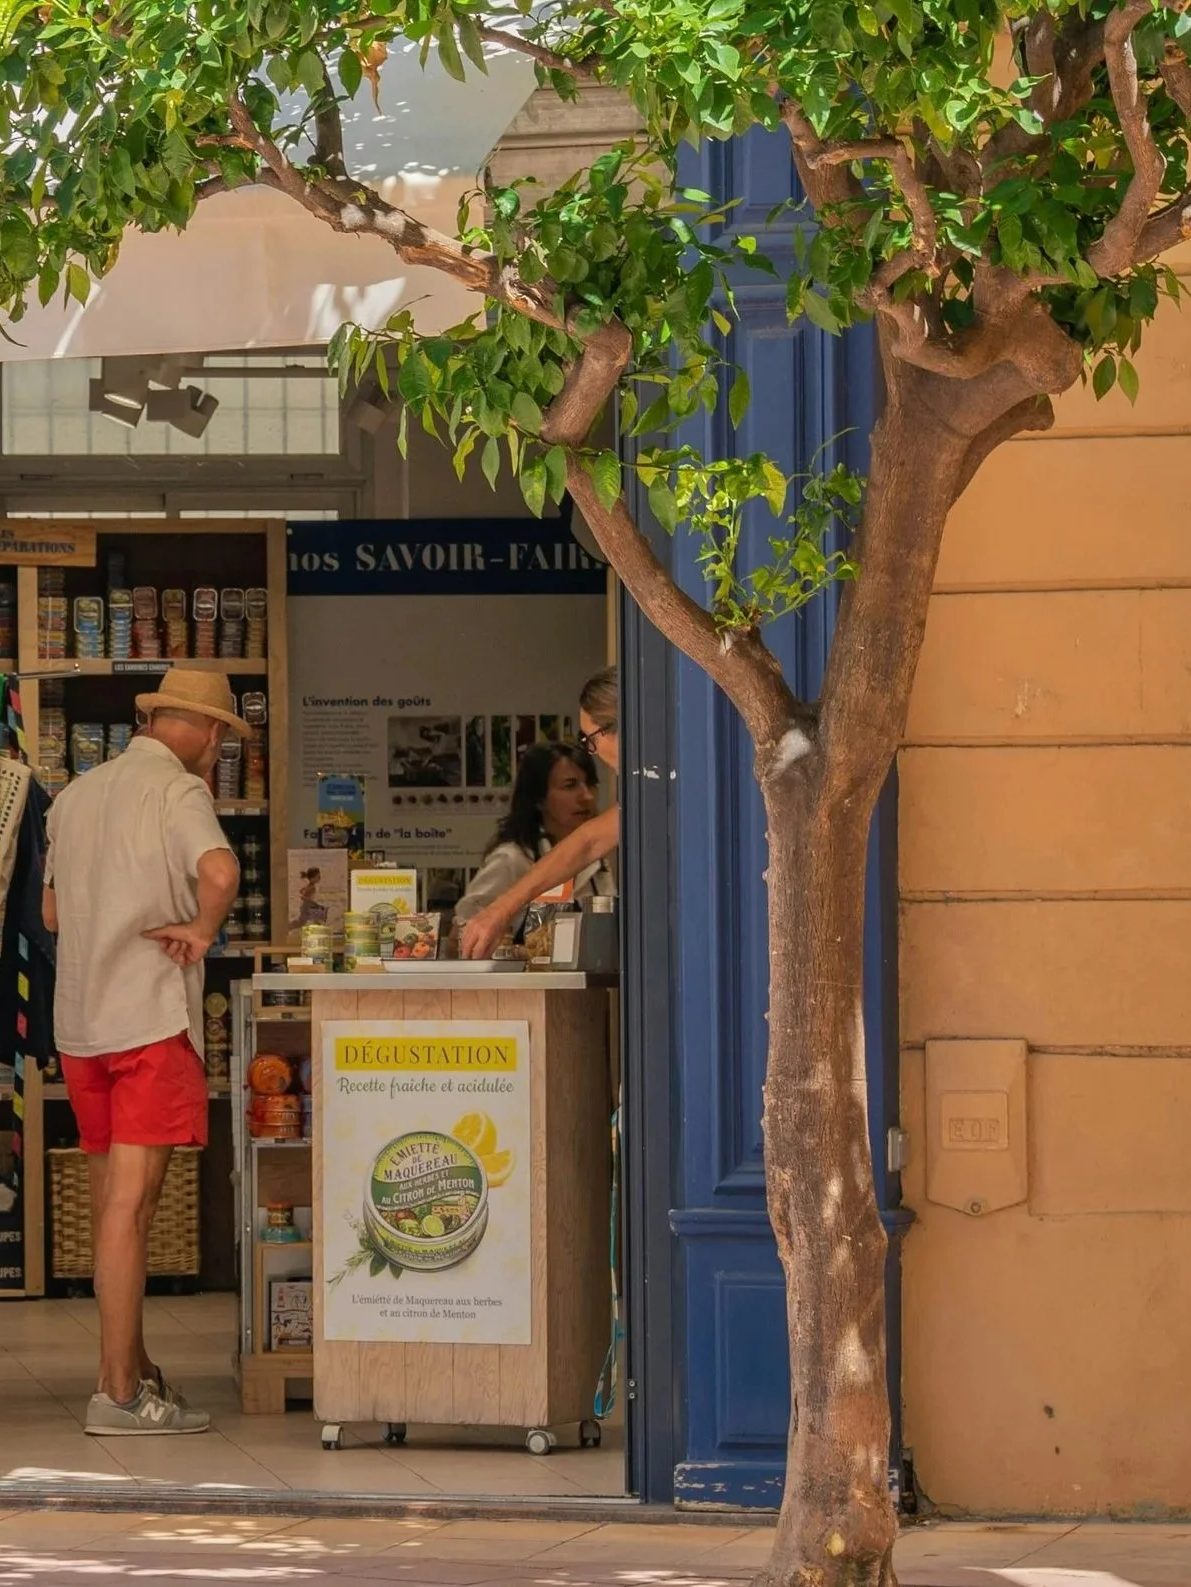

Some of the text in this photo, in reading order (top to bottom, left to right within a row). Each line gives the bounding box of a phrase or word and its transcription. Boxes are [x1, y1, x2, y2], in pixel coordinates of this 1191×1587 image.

[356, 543, 603, 571] SAVOIR-FAIR
[302, 695, 432, 710] L'invention des goûts
[375, 829, 391, 840] de
[344, 1040, 510, 1065] DÉGUSTATION
[337, 1076, 514, 1100] Recette fraîche et acidulée
[412, 1154, 422, 1163] DE
[383, 1153, 459, 1182] MAQUEREAU
[393, 1187, 425, 1204] CITRON
[426, 1187, 436, 1196] DE
[393, 1295, 404, 1305] de
[405, 1296, 454, 1307] Maquereau
[455, 1298, 472, 1306] aux
[473, 1296, 503, 1307] herbes
[379, 1308, 388, 1318] et
[402, 1309, 428, 1318] citron
[430, 1308, 441, 1319] de
[442, 1309, 477, 1319] Menton
